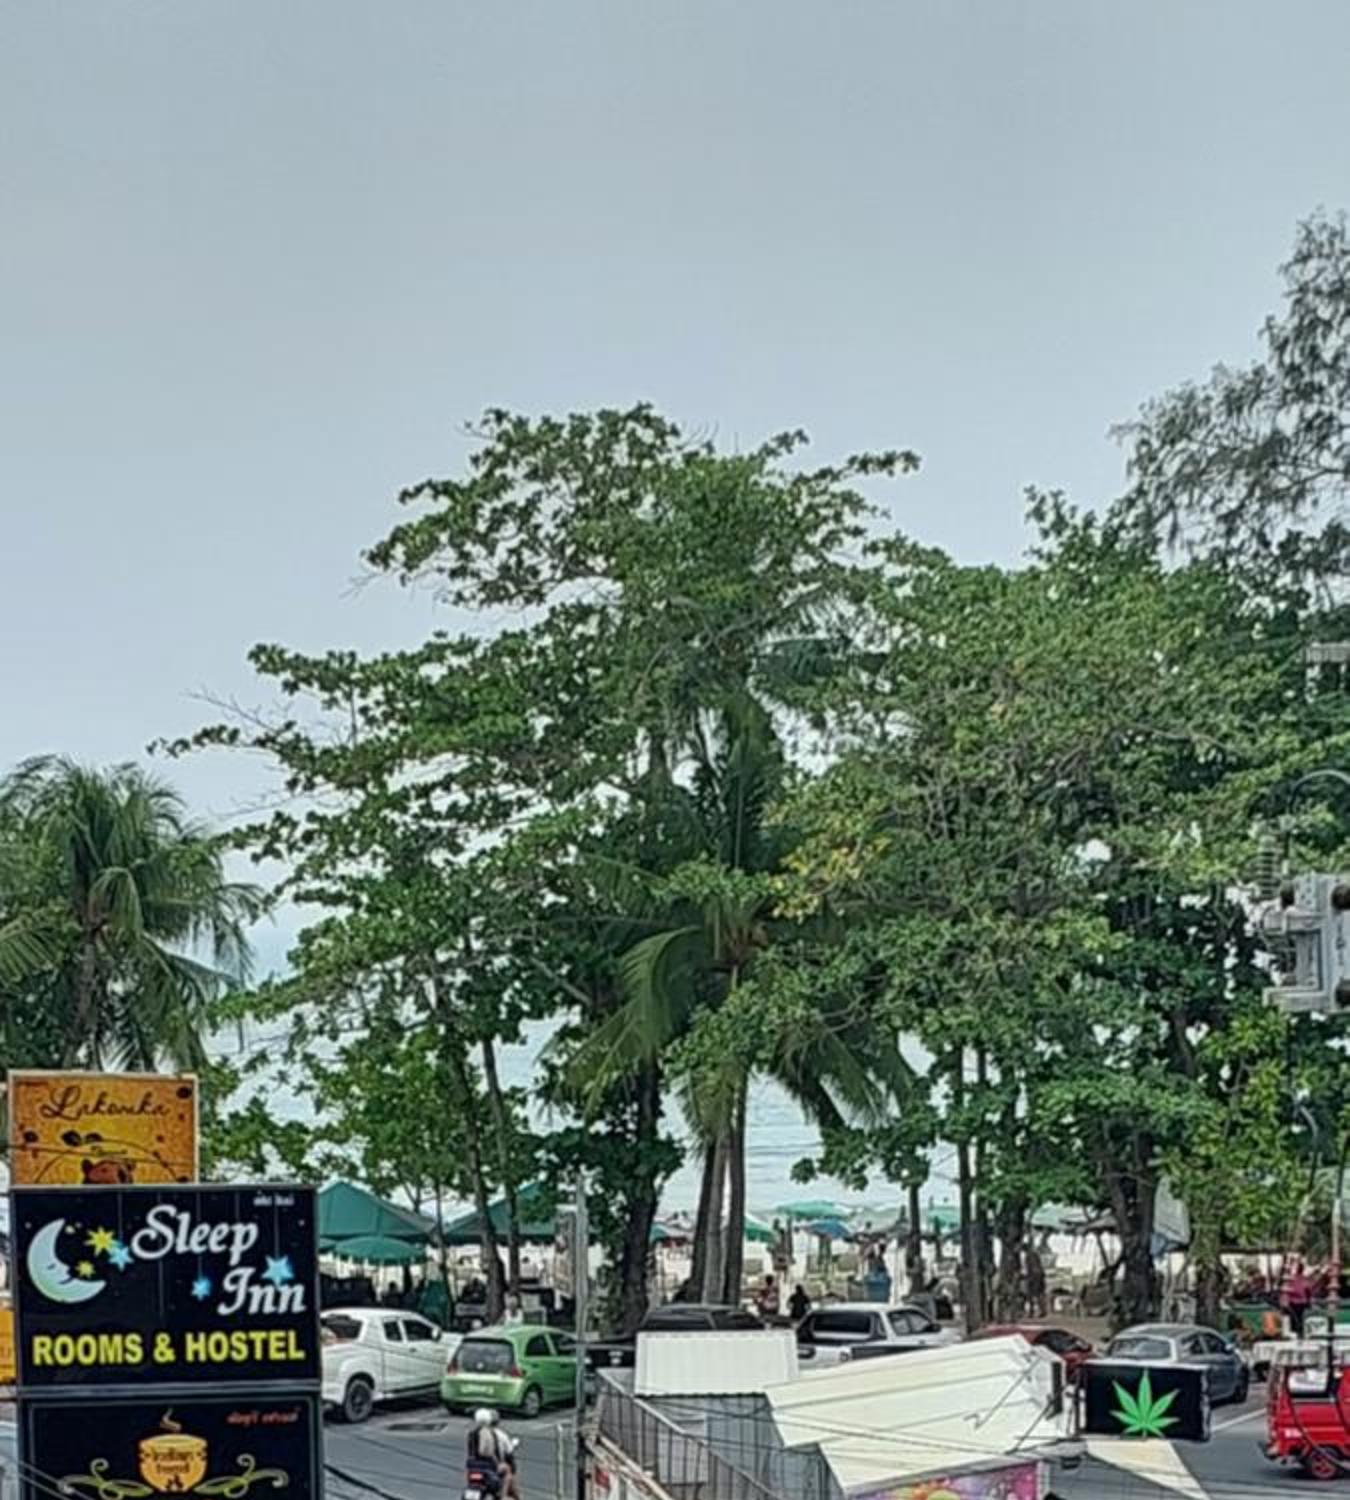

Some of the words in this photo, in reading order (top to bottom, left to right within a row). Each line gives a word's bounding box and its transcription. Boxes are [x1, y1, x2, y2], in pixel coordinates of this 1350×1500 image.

[131, 1204, 258, 1266] Sleep
[217, 1267, 306, 1315] Inn
[33, 1333, 143, 1365] ROOMS
[153, 1333, 175, 1362] &
[185, 1330, 305, 1362] HOSTEL
